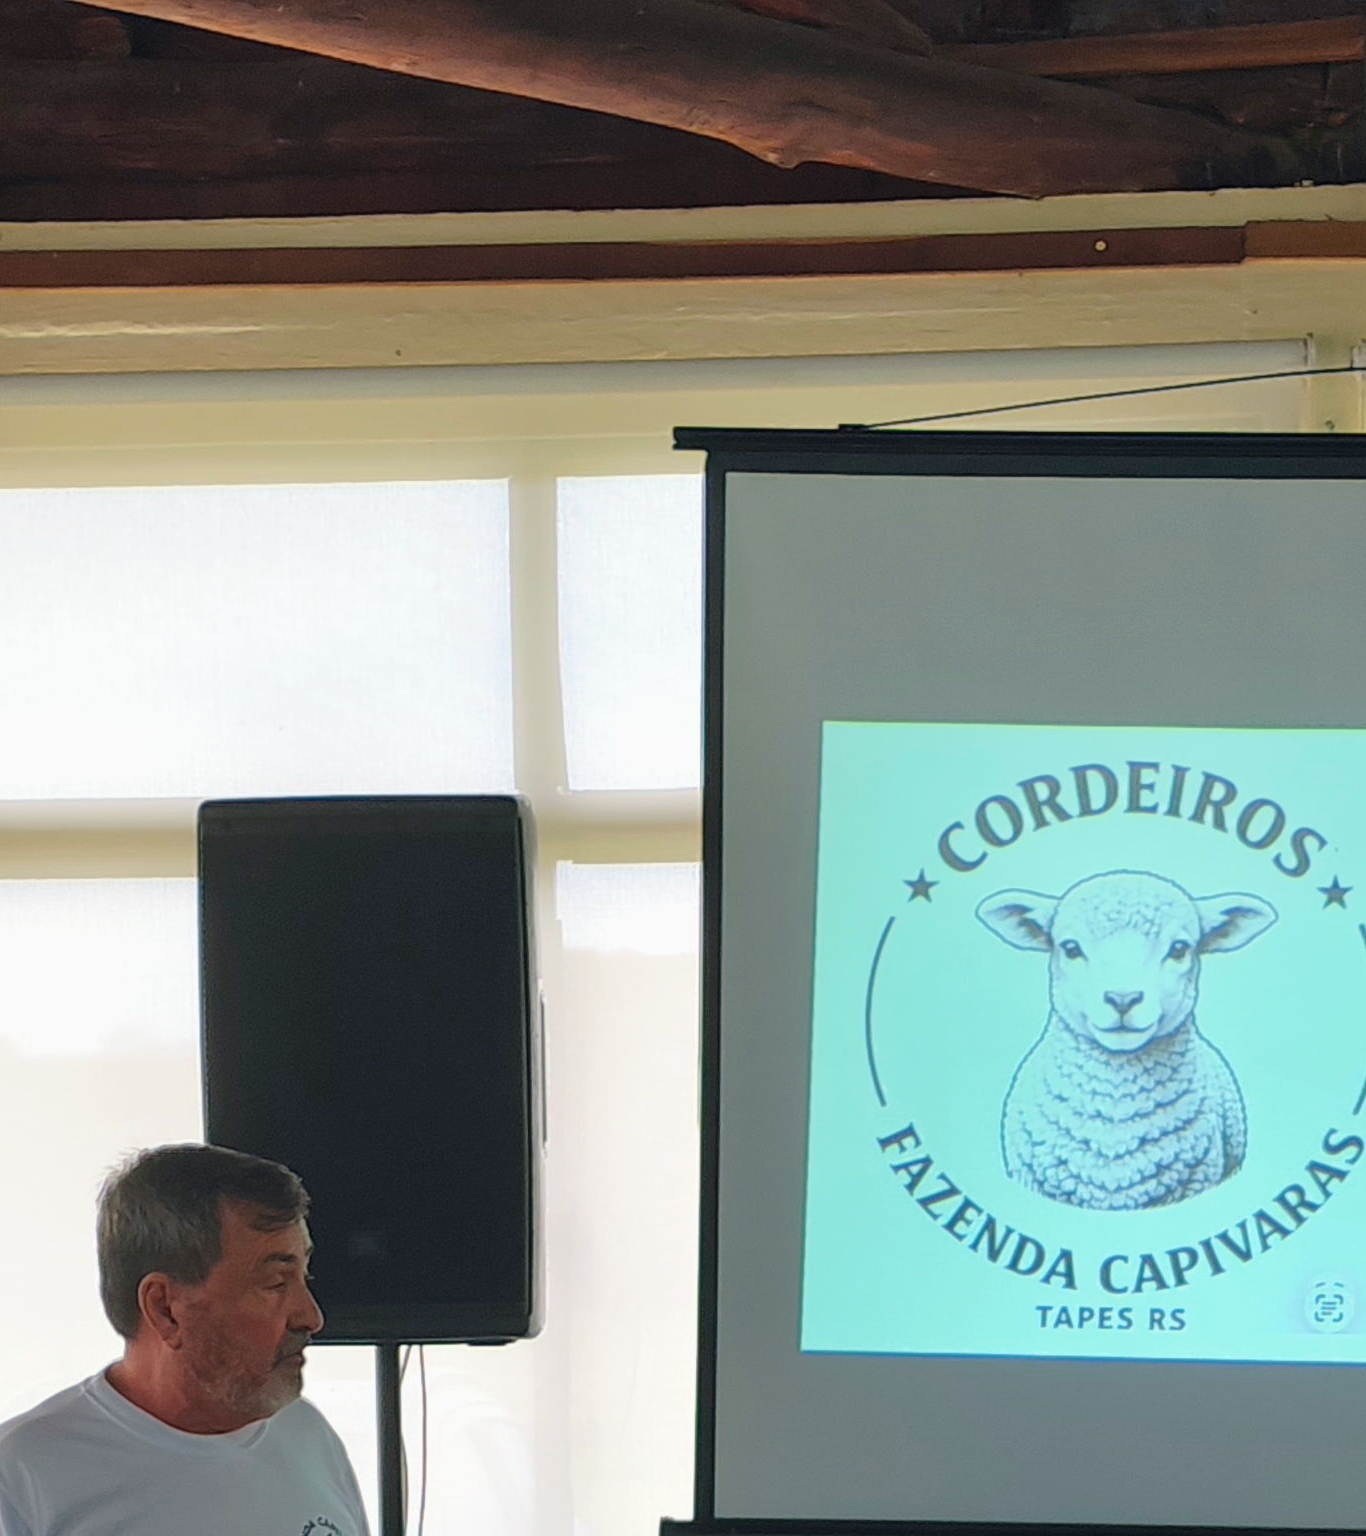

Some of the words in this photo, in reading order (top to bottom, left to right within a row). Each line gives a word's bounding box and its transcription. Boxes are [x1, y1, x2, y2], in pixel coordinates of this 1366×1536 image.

[938, 761, 1327, 878] CORDEIROS
[877, 1122, 1078, 1291] FAZENDA
[1099, 1128, 1366, 1294] CAPIVARAS
[1035, 1306, 1132, 1329] TAPES
[1149, 1308, 1185, 1330] RS
